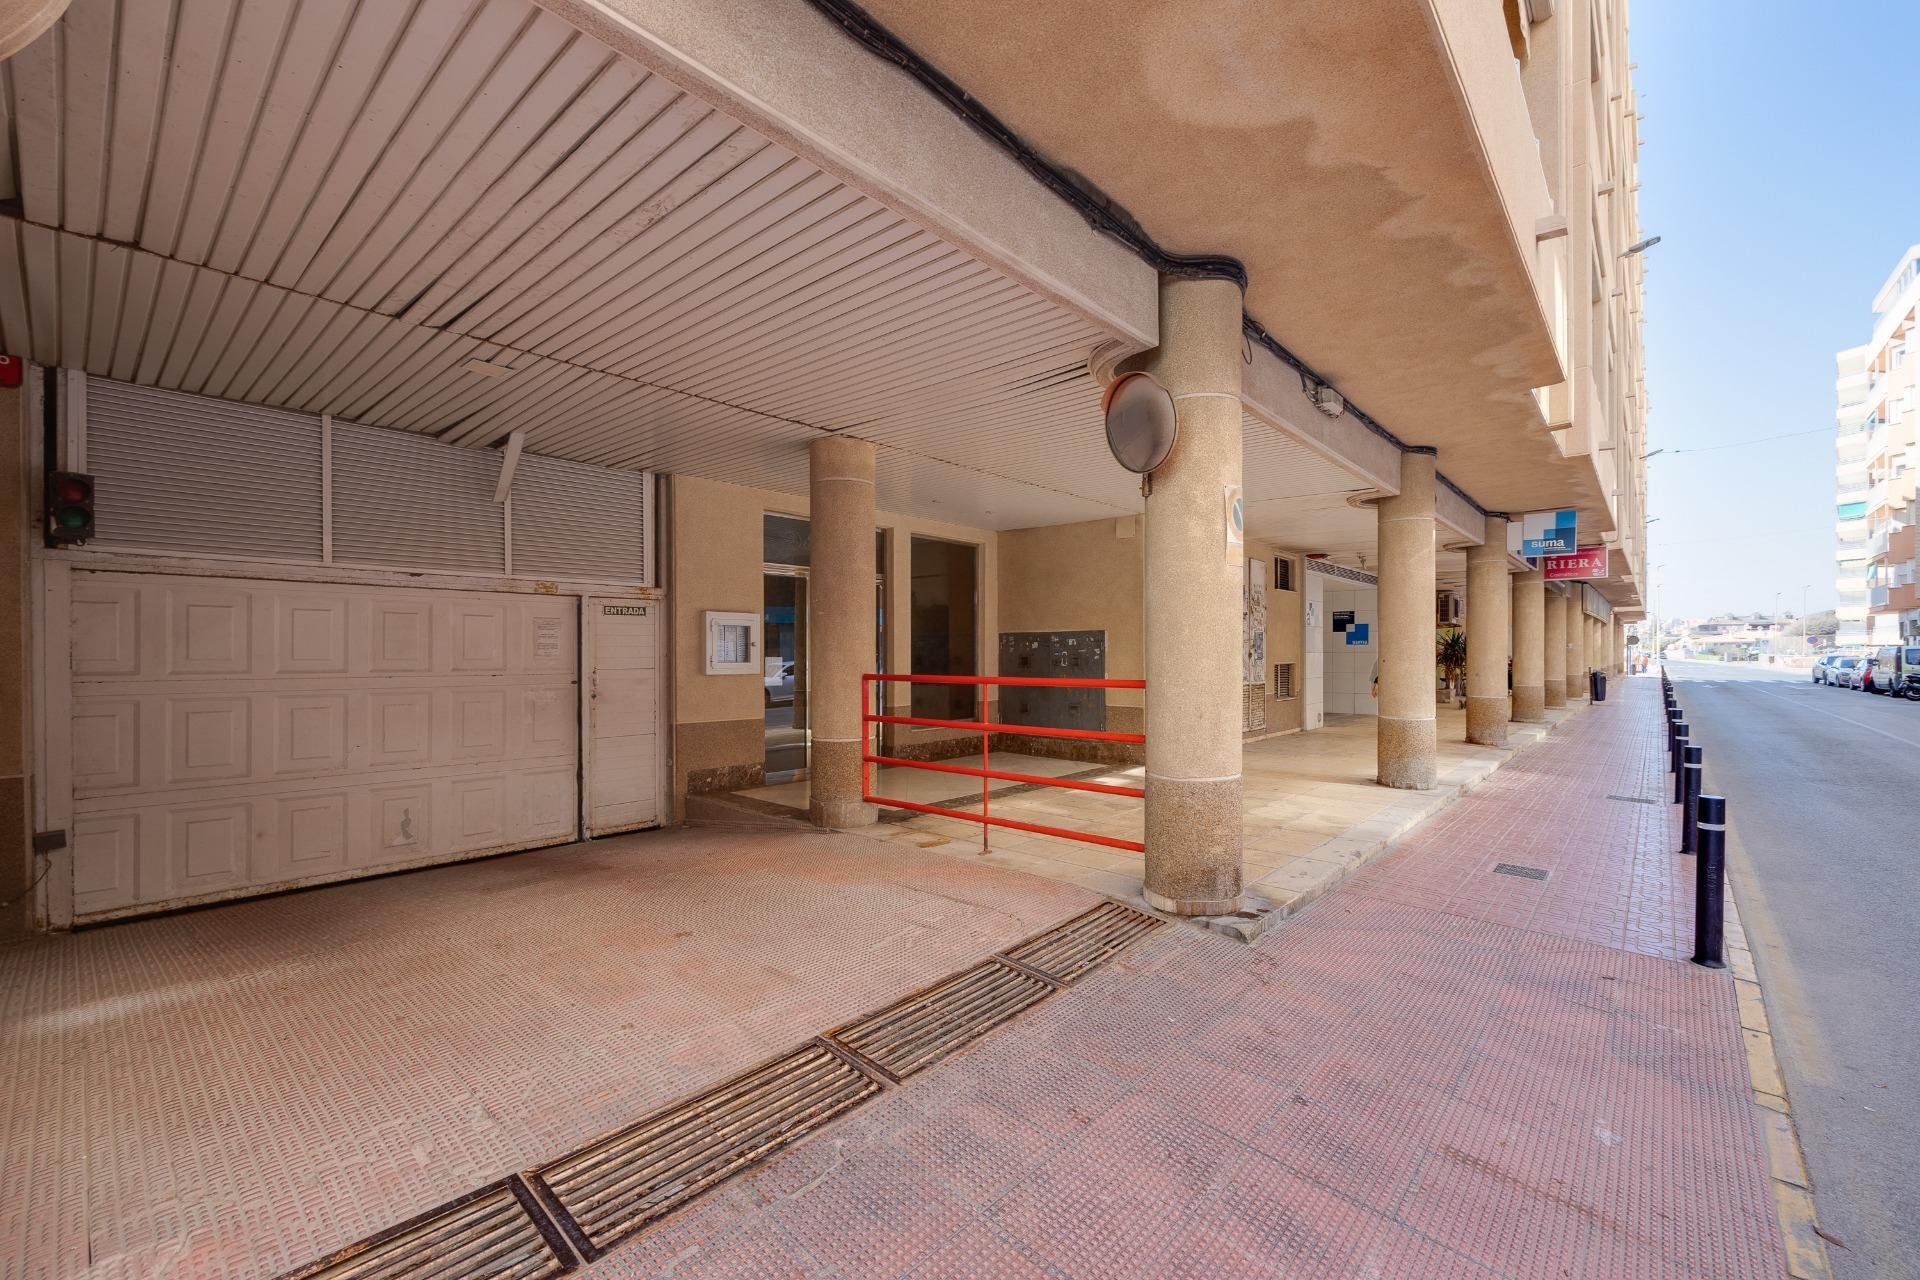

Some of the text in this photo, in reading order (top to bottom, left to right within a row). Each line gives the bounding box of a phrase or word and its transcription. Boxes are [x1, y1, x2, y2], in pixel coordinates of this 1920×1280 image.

[1531, 539, 1565, 548] suma
[1547, 558, 1602, 569] RIERA
[605, 606, 645, 615] ENTRADA
